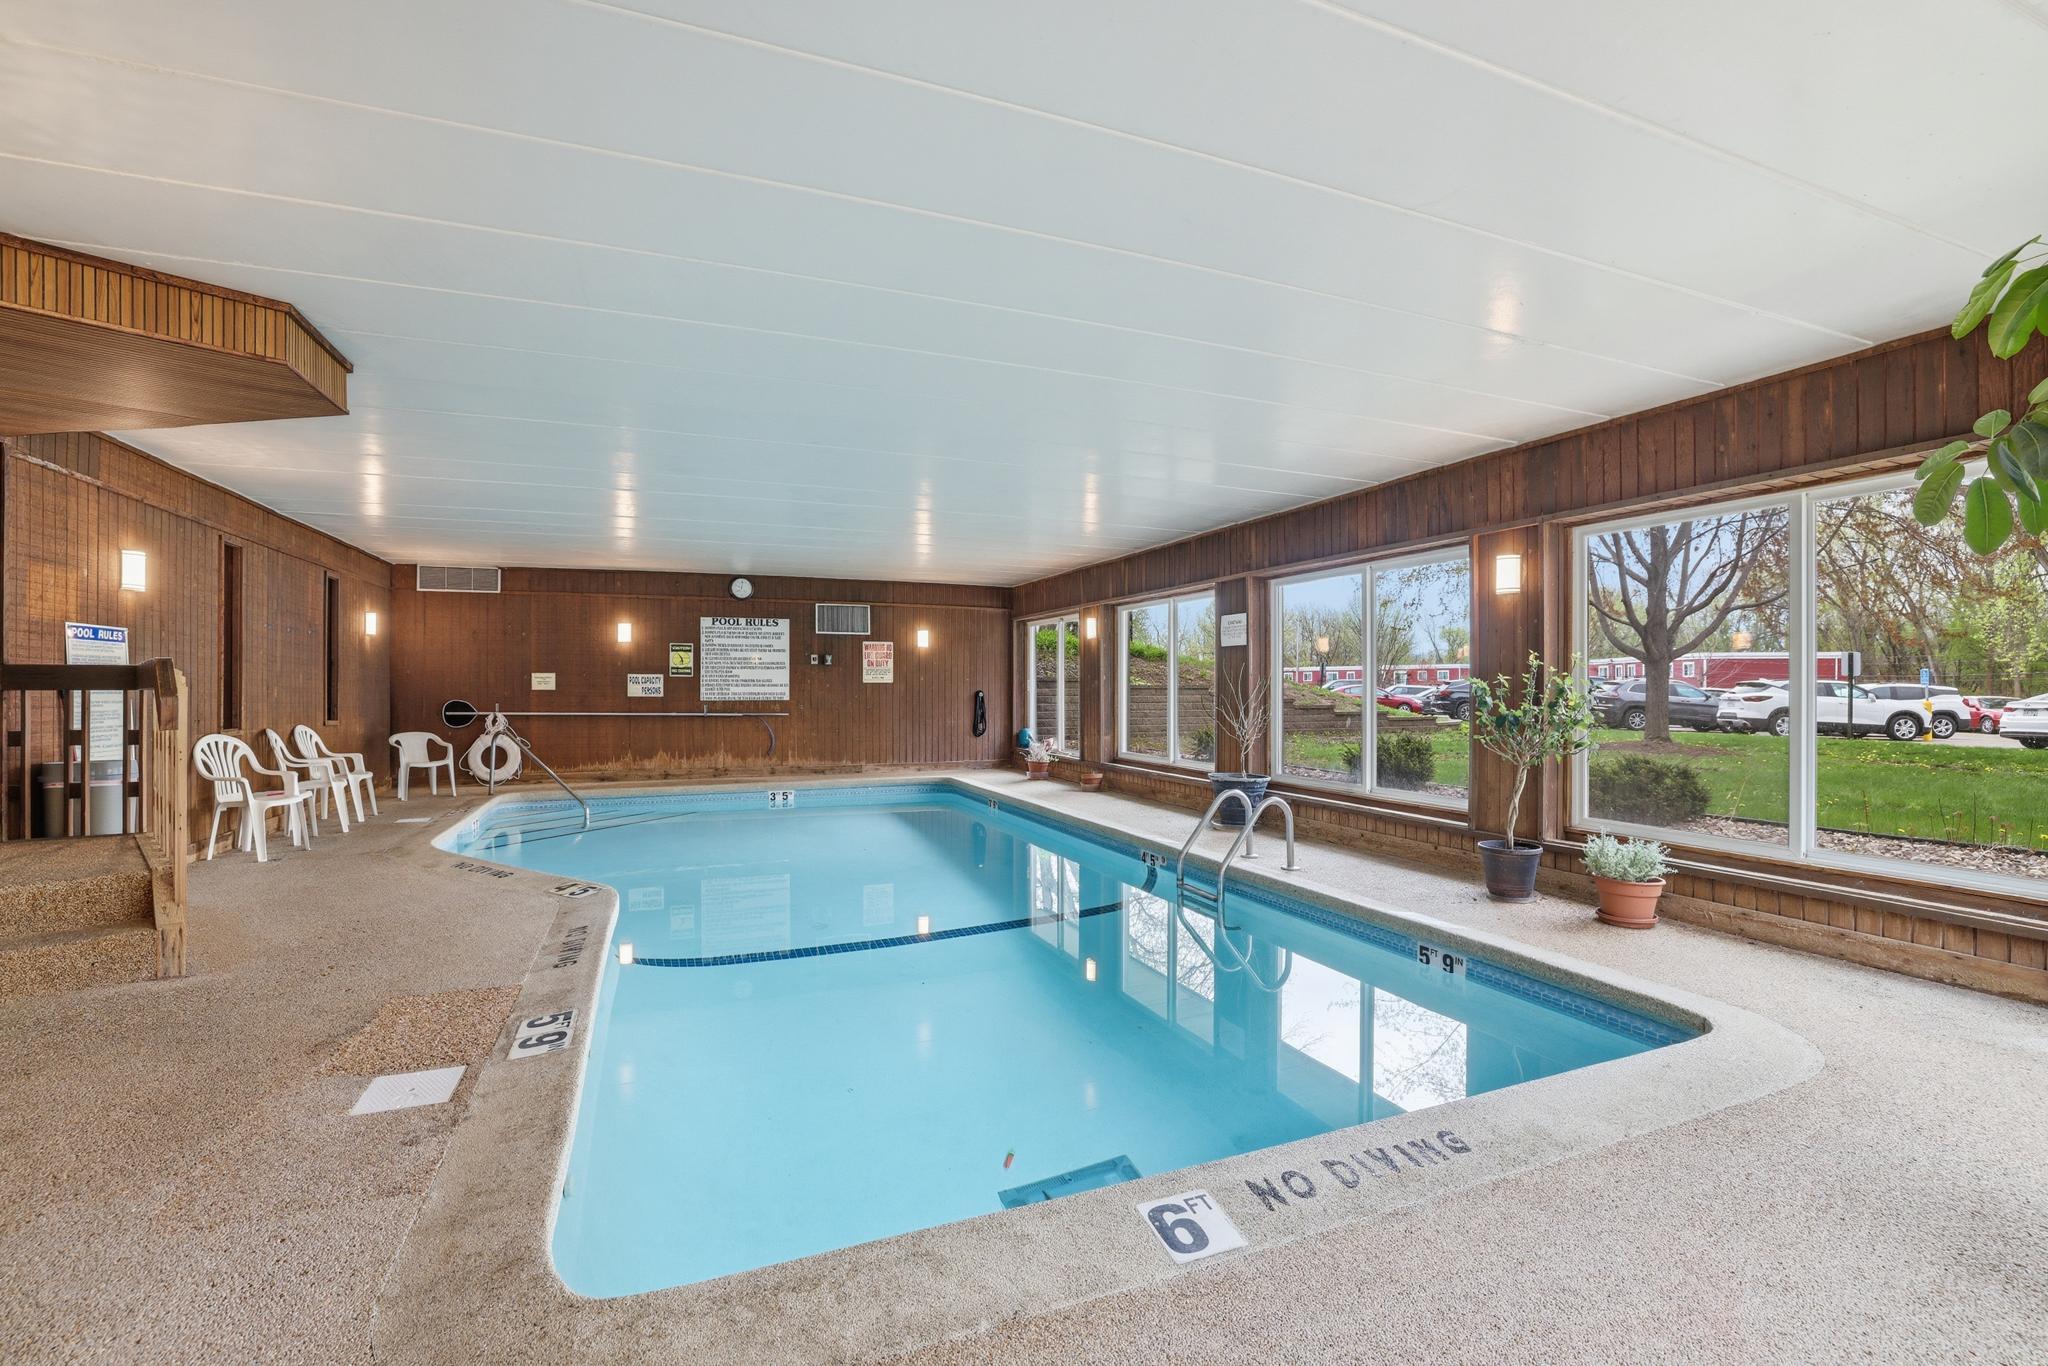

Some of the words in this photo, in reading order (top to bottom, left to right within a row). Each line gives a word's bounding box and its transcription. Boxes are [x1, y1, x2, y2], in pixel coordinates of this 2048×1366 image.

[711, 617, 742, 626] POOL
[745, 618, 779, 627] RULES
[70, 627, 95, 639] POOL
[97, 630, 123, 641] RULES
[629, 676, 641, 685] POOL
[641, 676, 662, 685] CAPACITY
[641, 686, 662, 695] PERSONS
[770, 792, 776, 801] 3
[782, 791, 789, 801] 5
[1141, 851, 1147, 864] 4
[1150, 853, 1156, 867] 5
[1419, 945, 1430, 965] 5
[1430, 949, 1438, 957] FT
[1442, 953, 1454, 974] 9
[1454, 956, 1464, 967] IN
[526, 1011, 574, 1029] 5
[518, 1031, 568, 1050] 9
[1244, 1170, 1316, 1212] NO
[1320, 1130, 1472, 1190] DIVING
[1147, 1203, 1210, 1254] 6
[1183, 1193, 1213, 1215] FT
